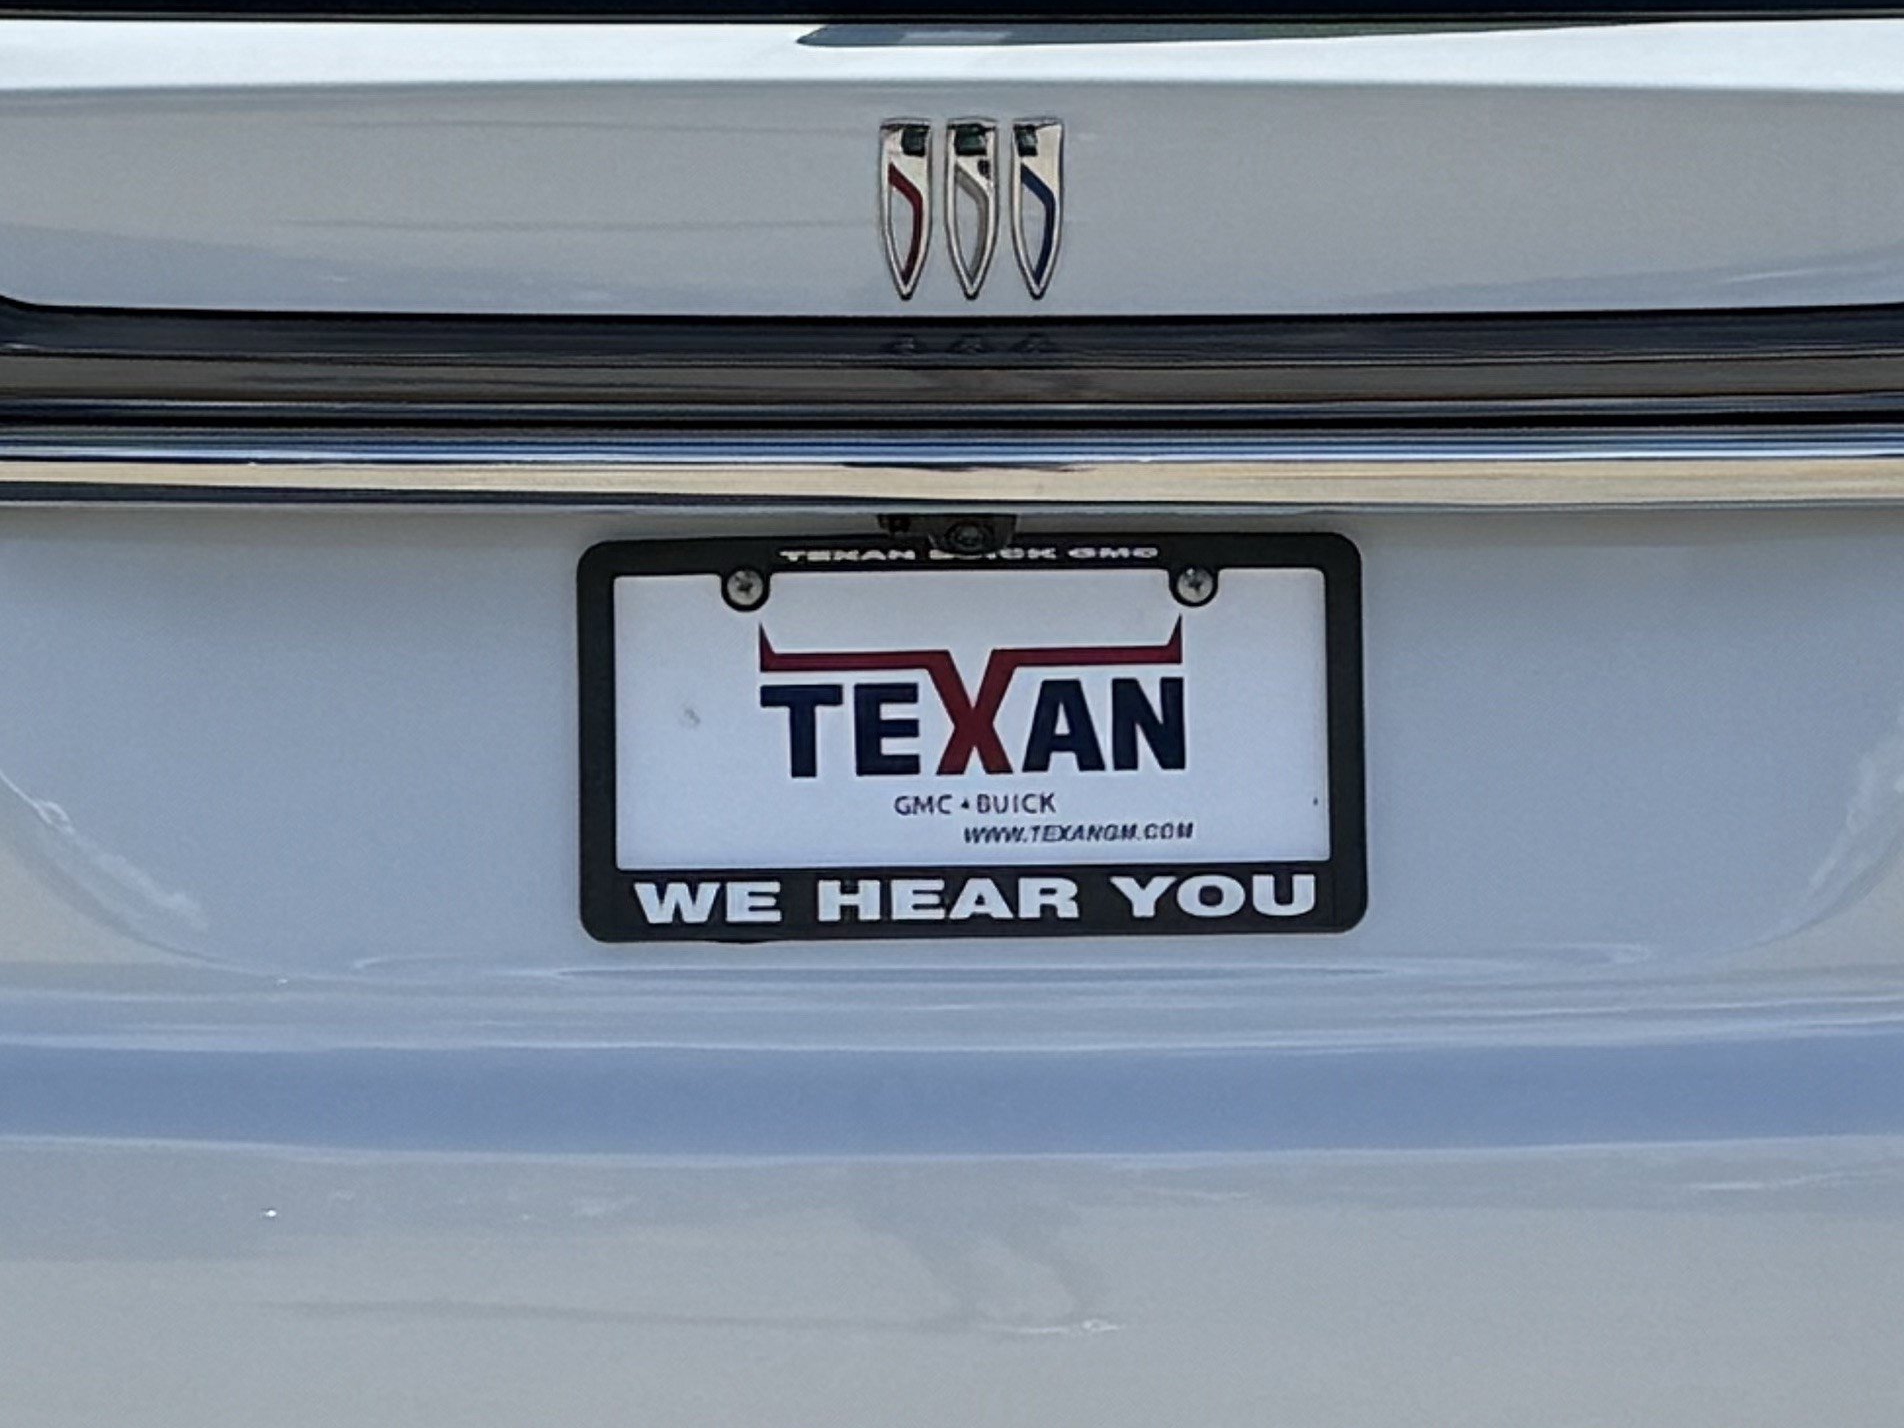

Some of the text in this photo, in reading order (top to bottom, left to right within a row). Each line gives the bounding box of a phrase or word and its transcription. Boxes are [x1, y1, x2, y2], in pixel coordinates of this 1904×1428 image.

[779, 548, 916, 563] TEXAN
[929, 546, 1057, 561] BCK
[759, 647, 1187, 778] TEXAN
[894, 792, 1057, 816] GMC BUICK
[963, 822, 1195, 845] WWW.TEXANGM.COM
[633, 873, 1317, 926] WE HEAR YOU
